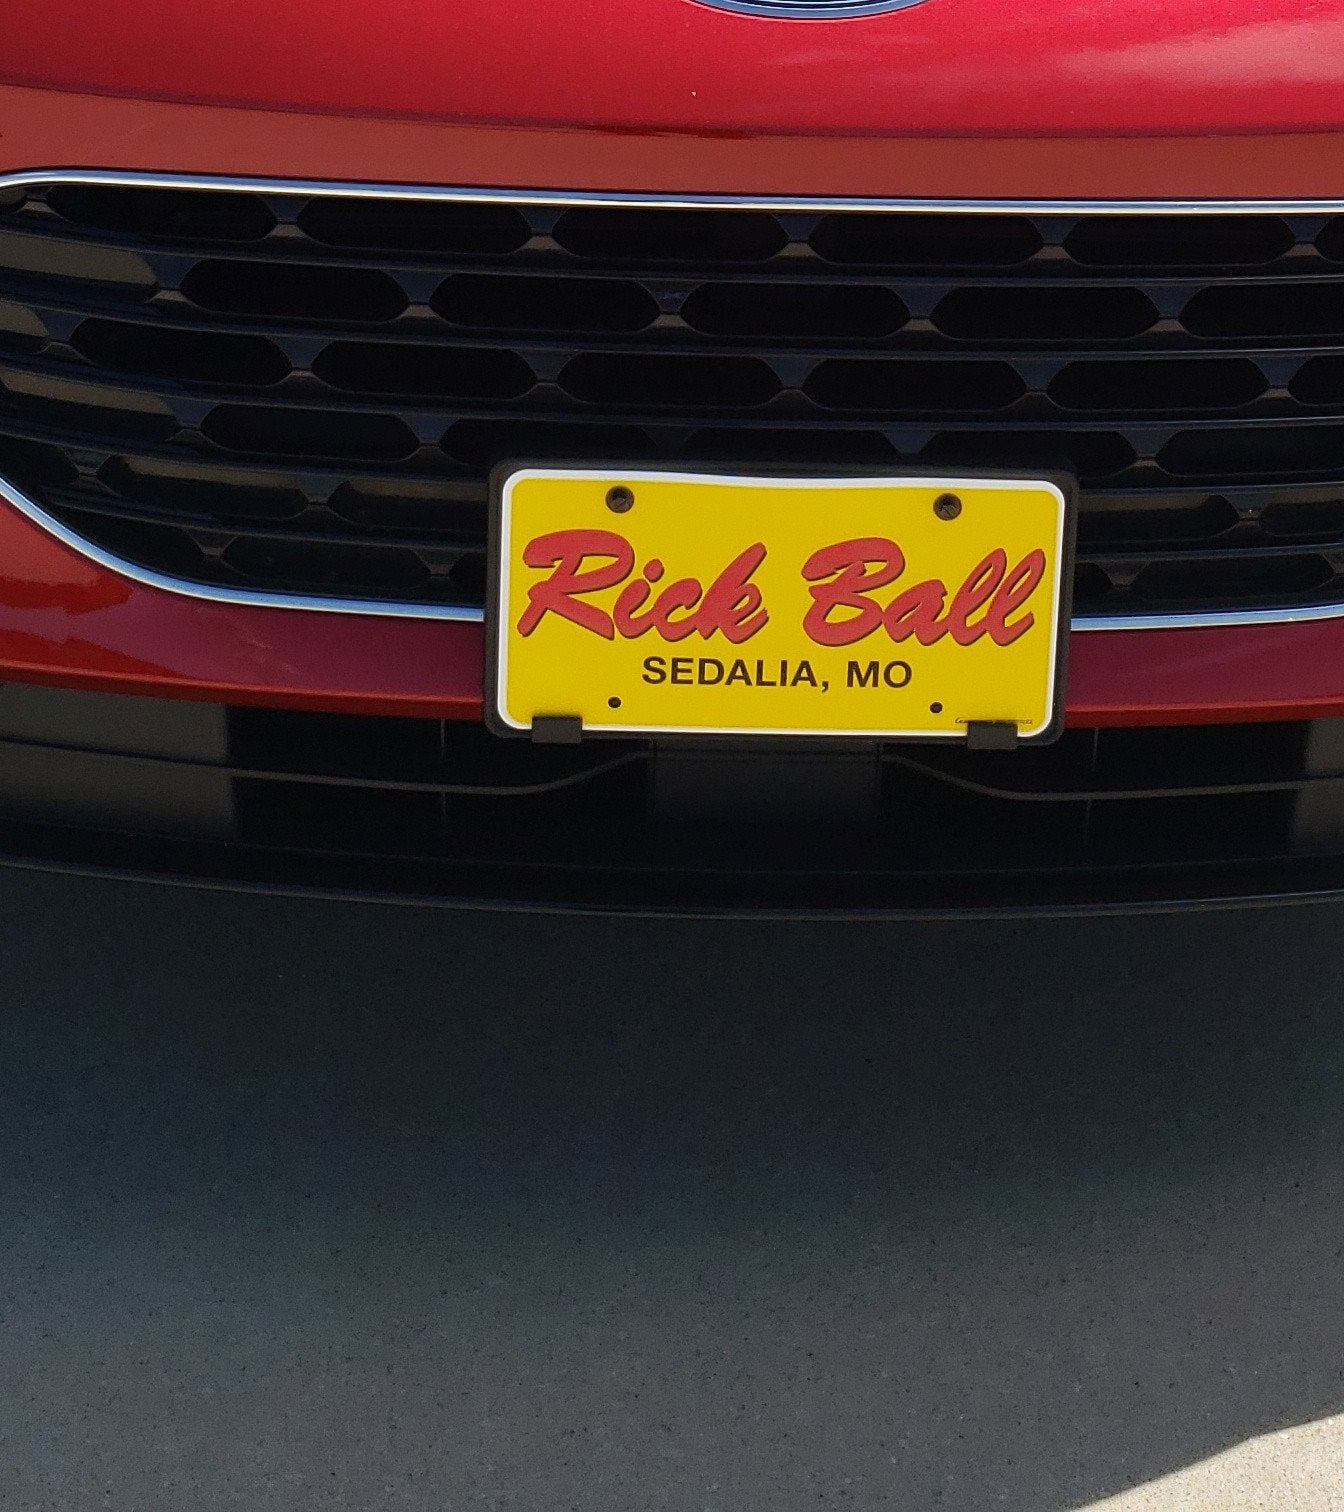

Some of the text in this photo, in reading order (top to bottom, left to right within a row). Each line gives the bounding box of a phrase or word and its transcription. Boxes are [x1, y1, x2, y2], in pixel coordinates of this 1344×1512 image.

[517, 528, 1047, 647] Rick Ball
[641, 656, 913, 693] SEDALIA, MO
